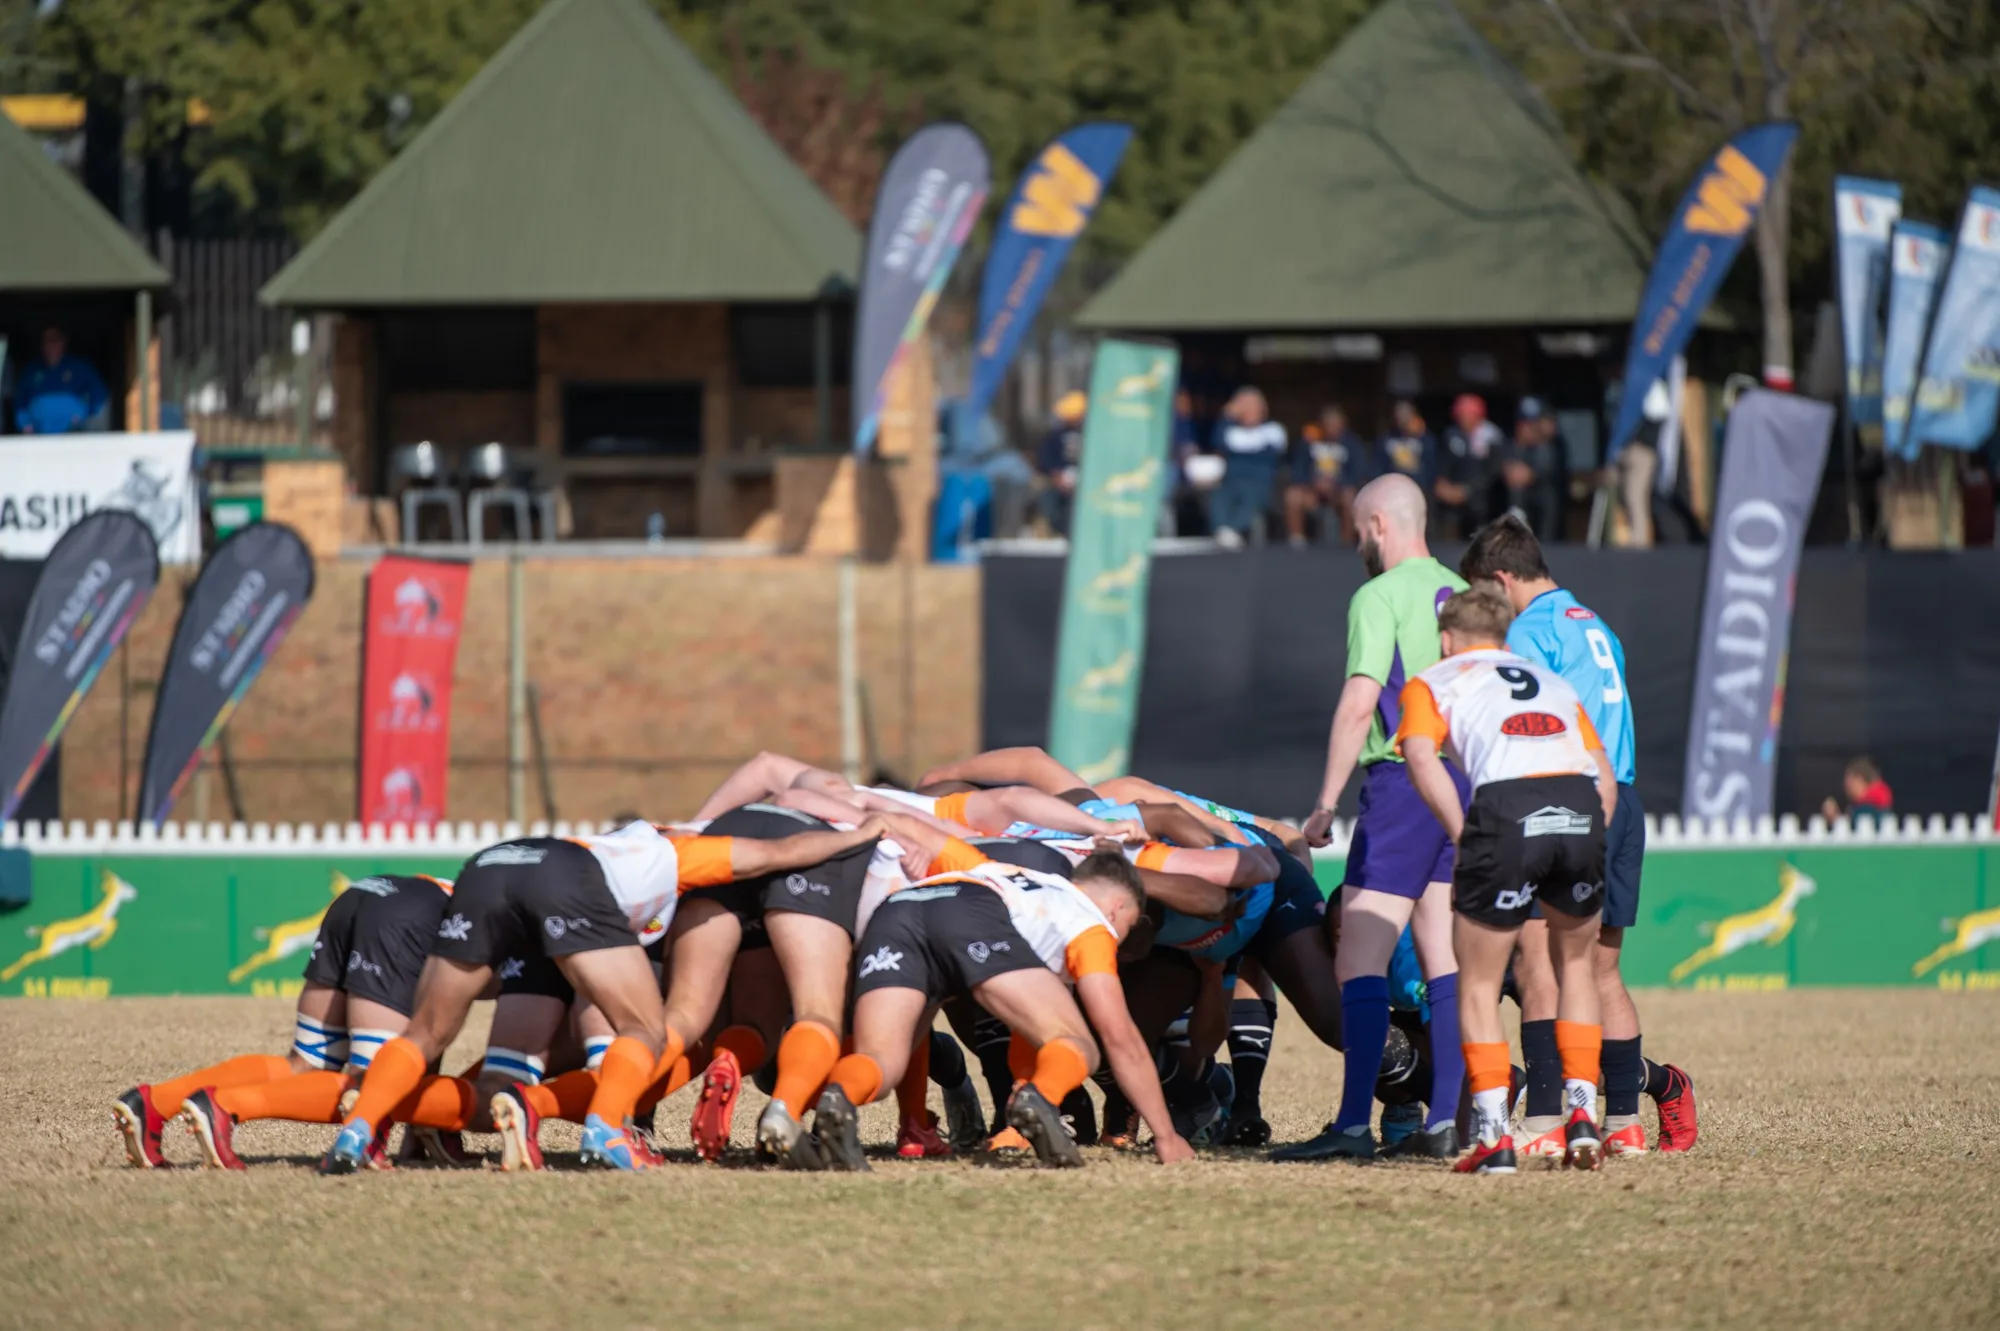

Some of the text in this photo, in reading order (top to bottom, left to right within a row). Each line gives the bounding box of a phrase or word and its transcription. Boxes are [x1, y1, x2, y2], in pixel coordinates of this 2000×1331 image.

[1496, 666, 1540, 700] 9
[1586, 628, 1624, 704] 9
[1698, 499, 1788, 822] STADIO
